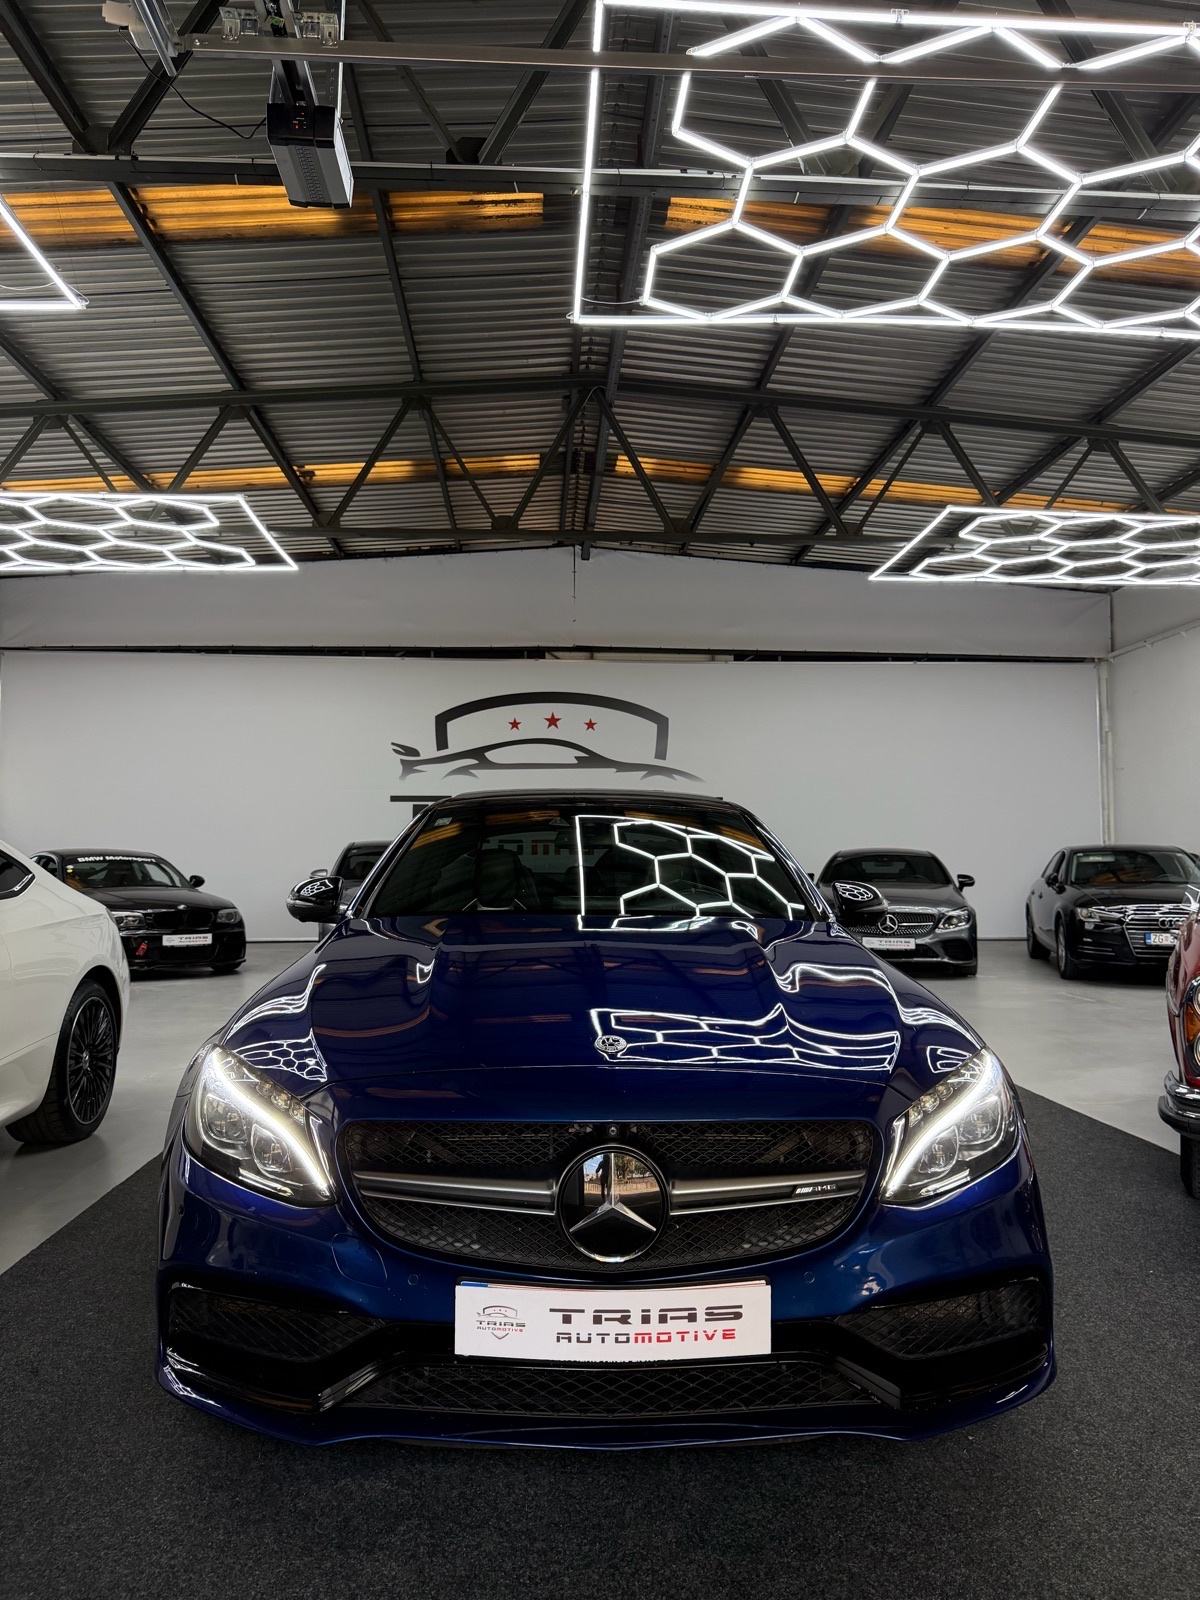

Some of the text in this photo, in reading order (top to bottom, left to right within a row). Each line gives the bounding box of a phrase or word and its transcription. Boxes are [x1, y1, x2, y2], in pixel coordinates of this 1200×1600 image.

[1152, 934, 1164, 944] ZG
[549, 1304, 743, 1325] TRIAS
[476, 1319, 526, 1328] TRIAS
[476, 1325, 524, 1333] AUTOMOTIVE
[556, 1328, 736, 1344] AUTOMOTIVE
